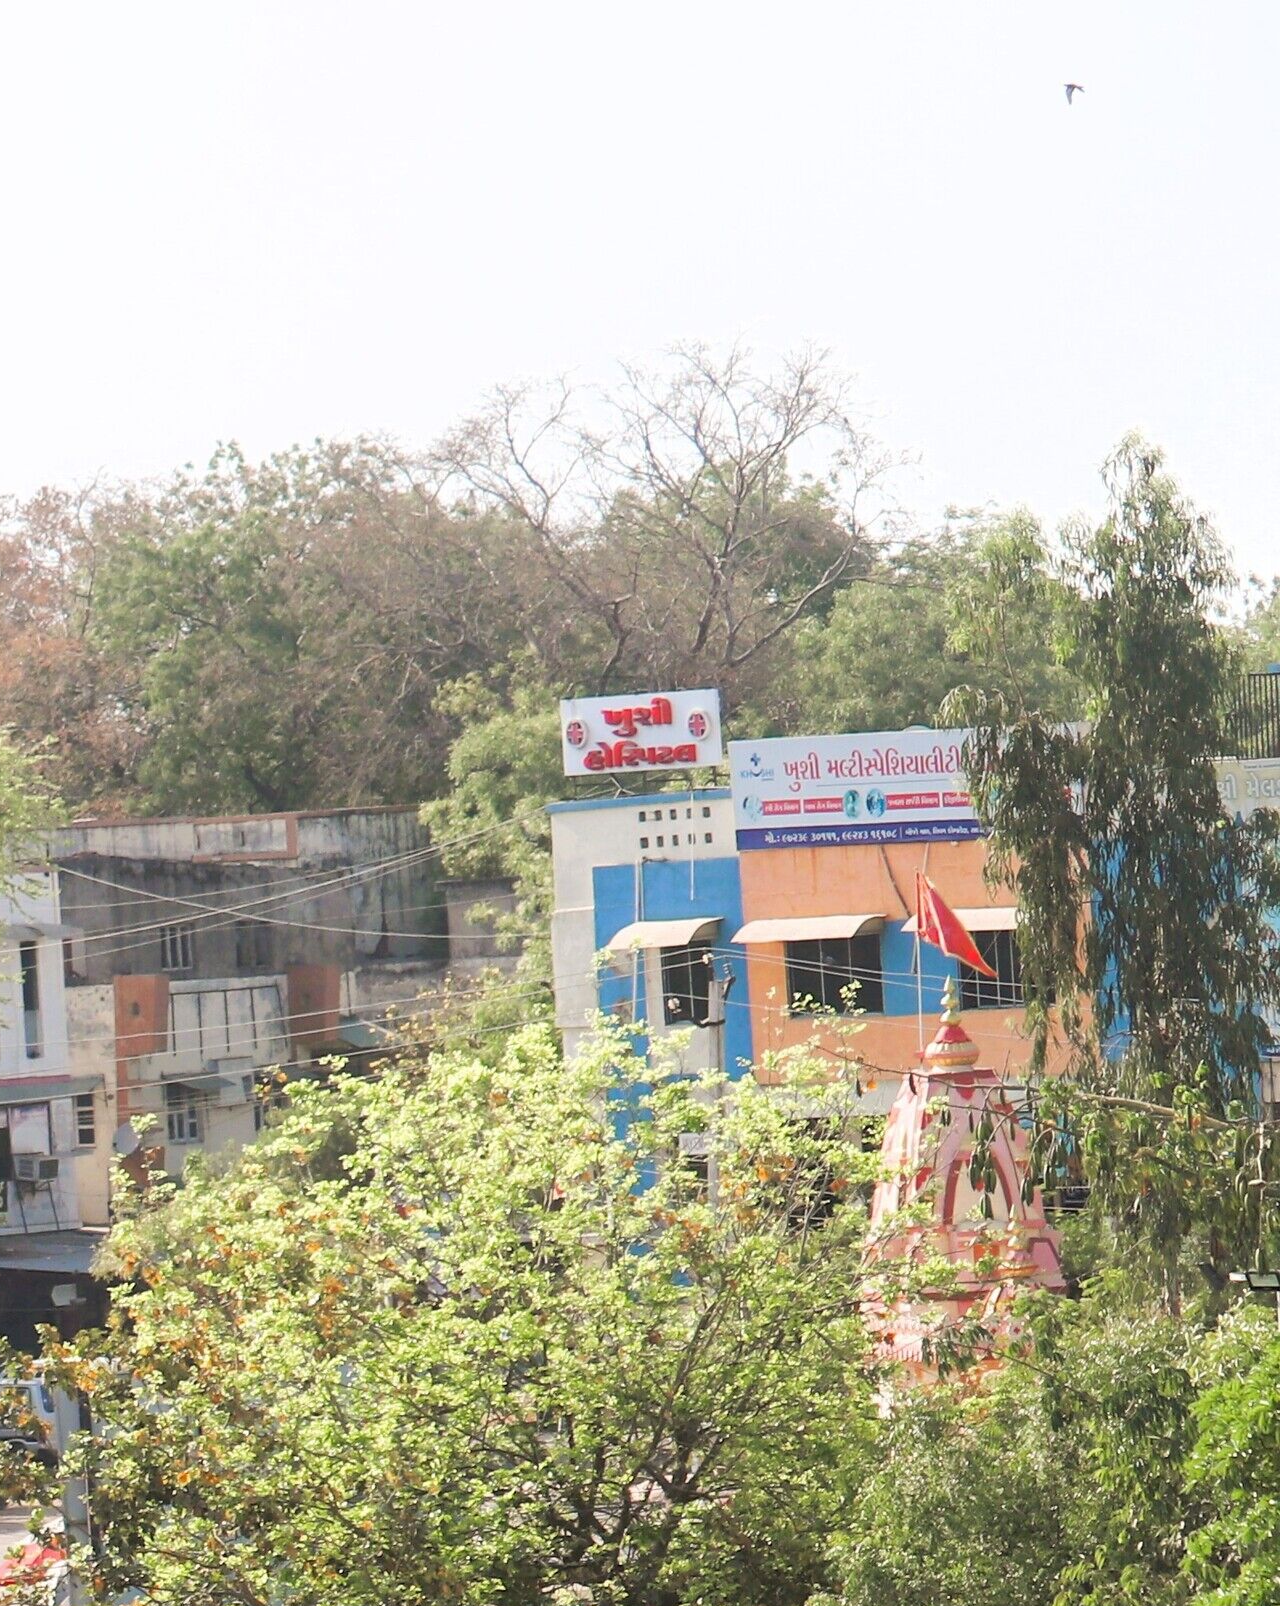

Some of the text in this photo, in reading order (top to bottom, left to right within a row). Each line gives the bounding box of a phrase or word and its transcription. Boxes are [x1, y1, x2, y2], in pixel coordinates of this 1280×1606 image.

[601, 697, 673, 737] ખુશી
[583, 740, 697, 770] હોસ્પિટલ
[783, 751, 822, 792] ખુશી
